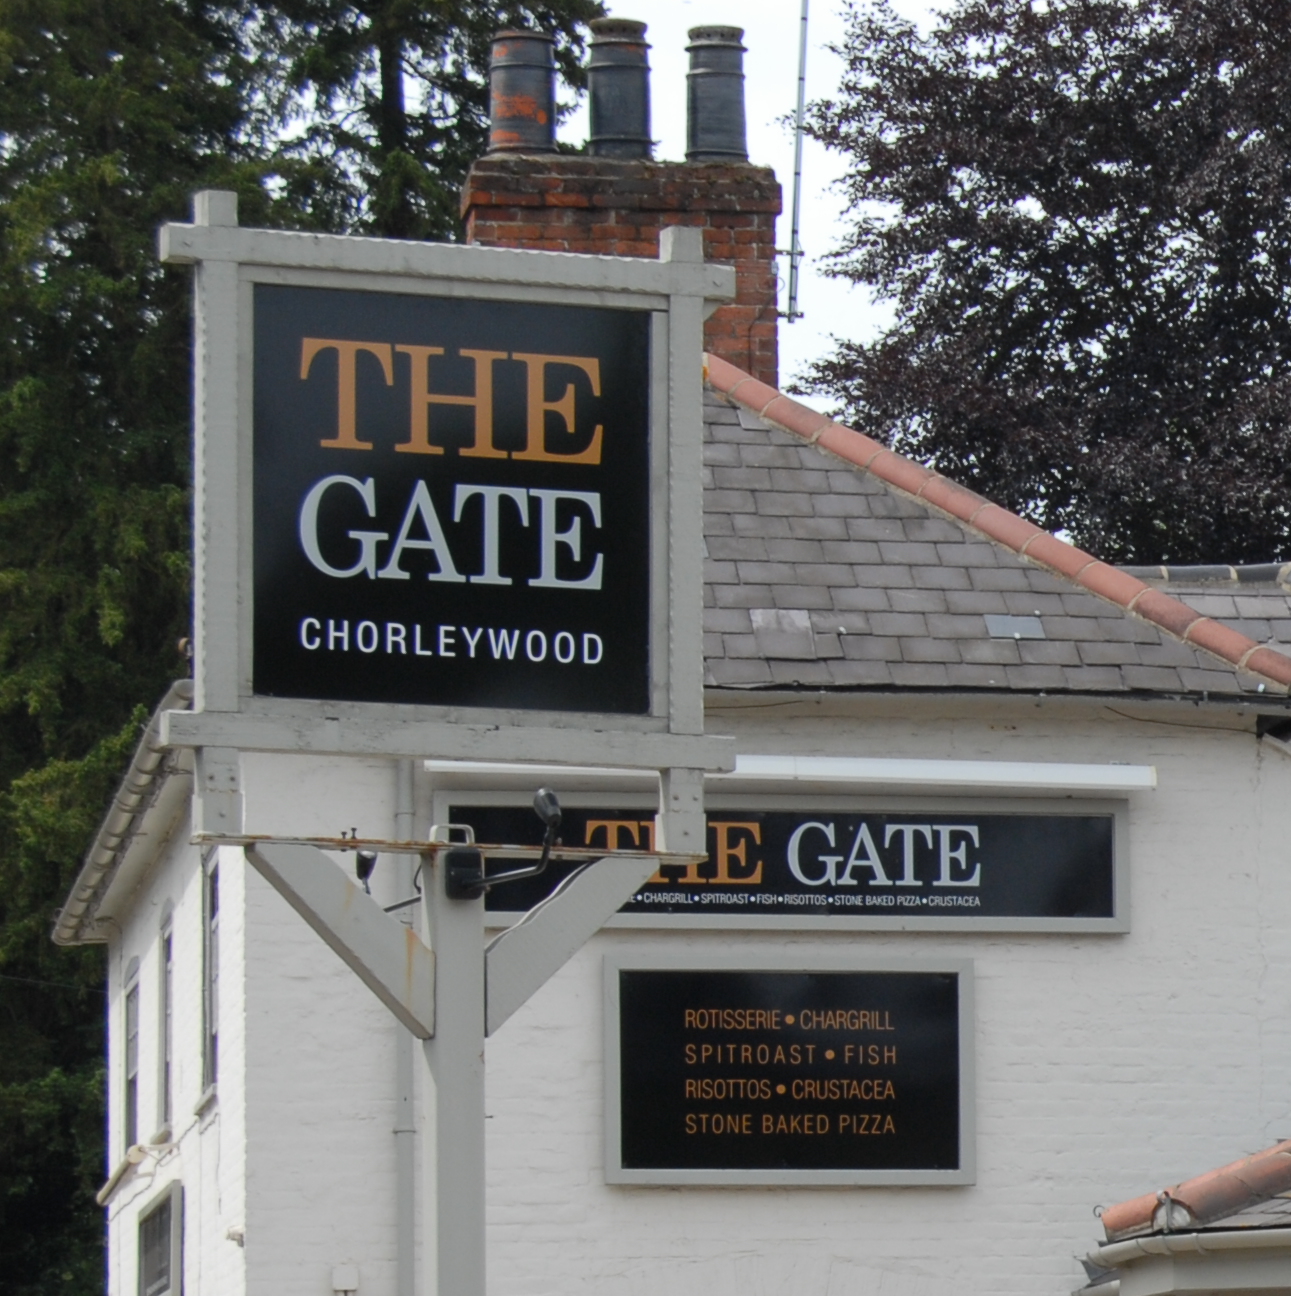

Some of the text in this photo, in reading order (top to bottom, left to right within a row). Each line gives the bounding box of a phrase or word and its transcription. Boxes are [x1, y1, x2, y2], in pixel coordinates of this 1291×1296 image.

[300, 337, 603, 464] THE
[300, 474, 603, 590] GATE
[300, 617, 604, 665] CHORLEYWOOD
[787, 821, 981, 887] GATE
[643, 892, 694, 904] CHARGRILL
[700, 893, 749, 905] SPITROAST
[756, 893, 778, 905] FISH
[784, 894, 827, 906] RISOTTOS
[834, 894, 864, 906] STONE
[865, 894, 895, 906] BAKED
[896, 895, 922, 907] PIZZA
[928, 895, 981, 907] CRUSTACEA
[685, 1009, 895, 1030] ROTISSERIE CHARGRILL
[685, 1044, 897, 1065] SPITROAST FISH
[685, 1079, 896, 1099] RISOTTOS CRUSTACEA
[685, 1114, 896, 1134] STONE BAKED PIZZA
